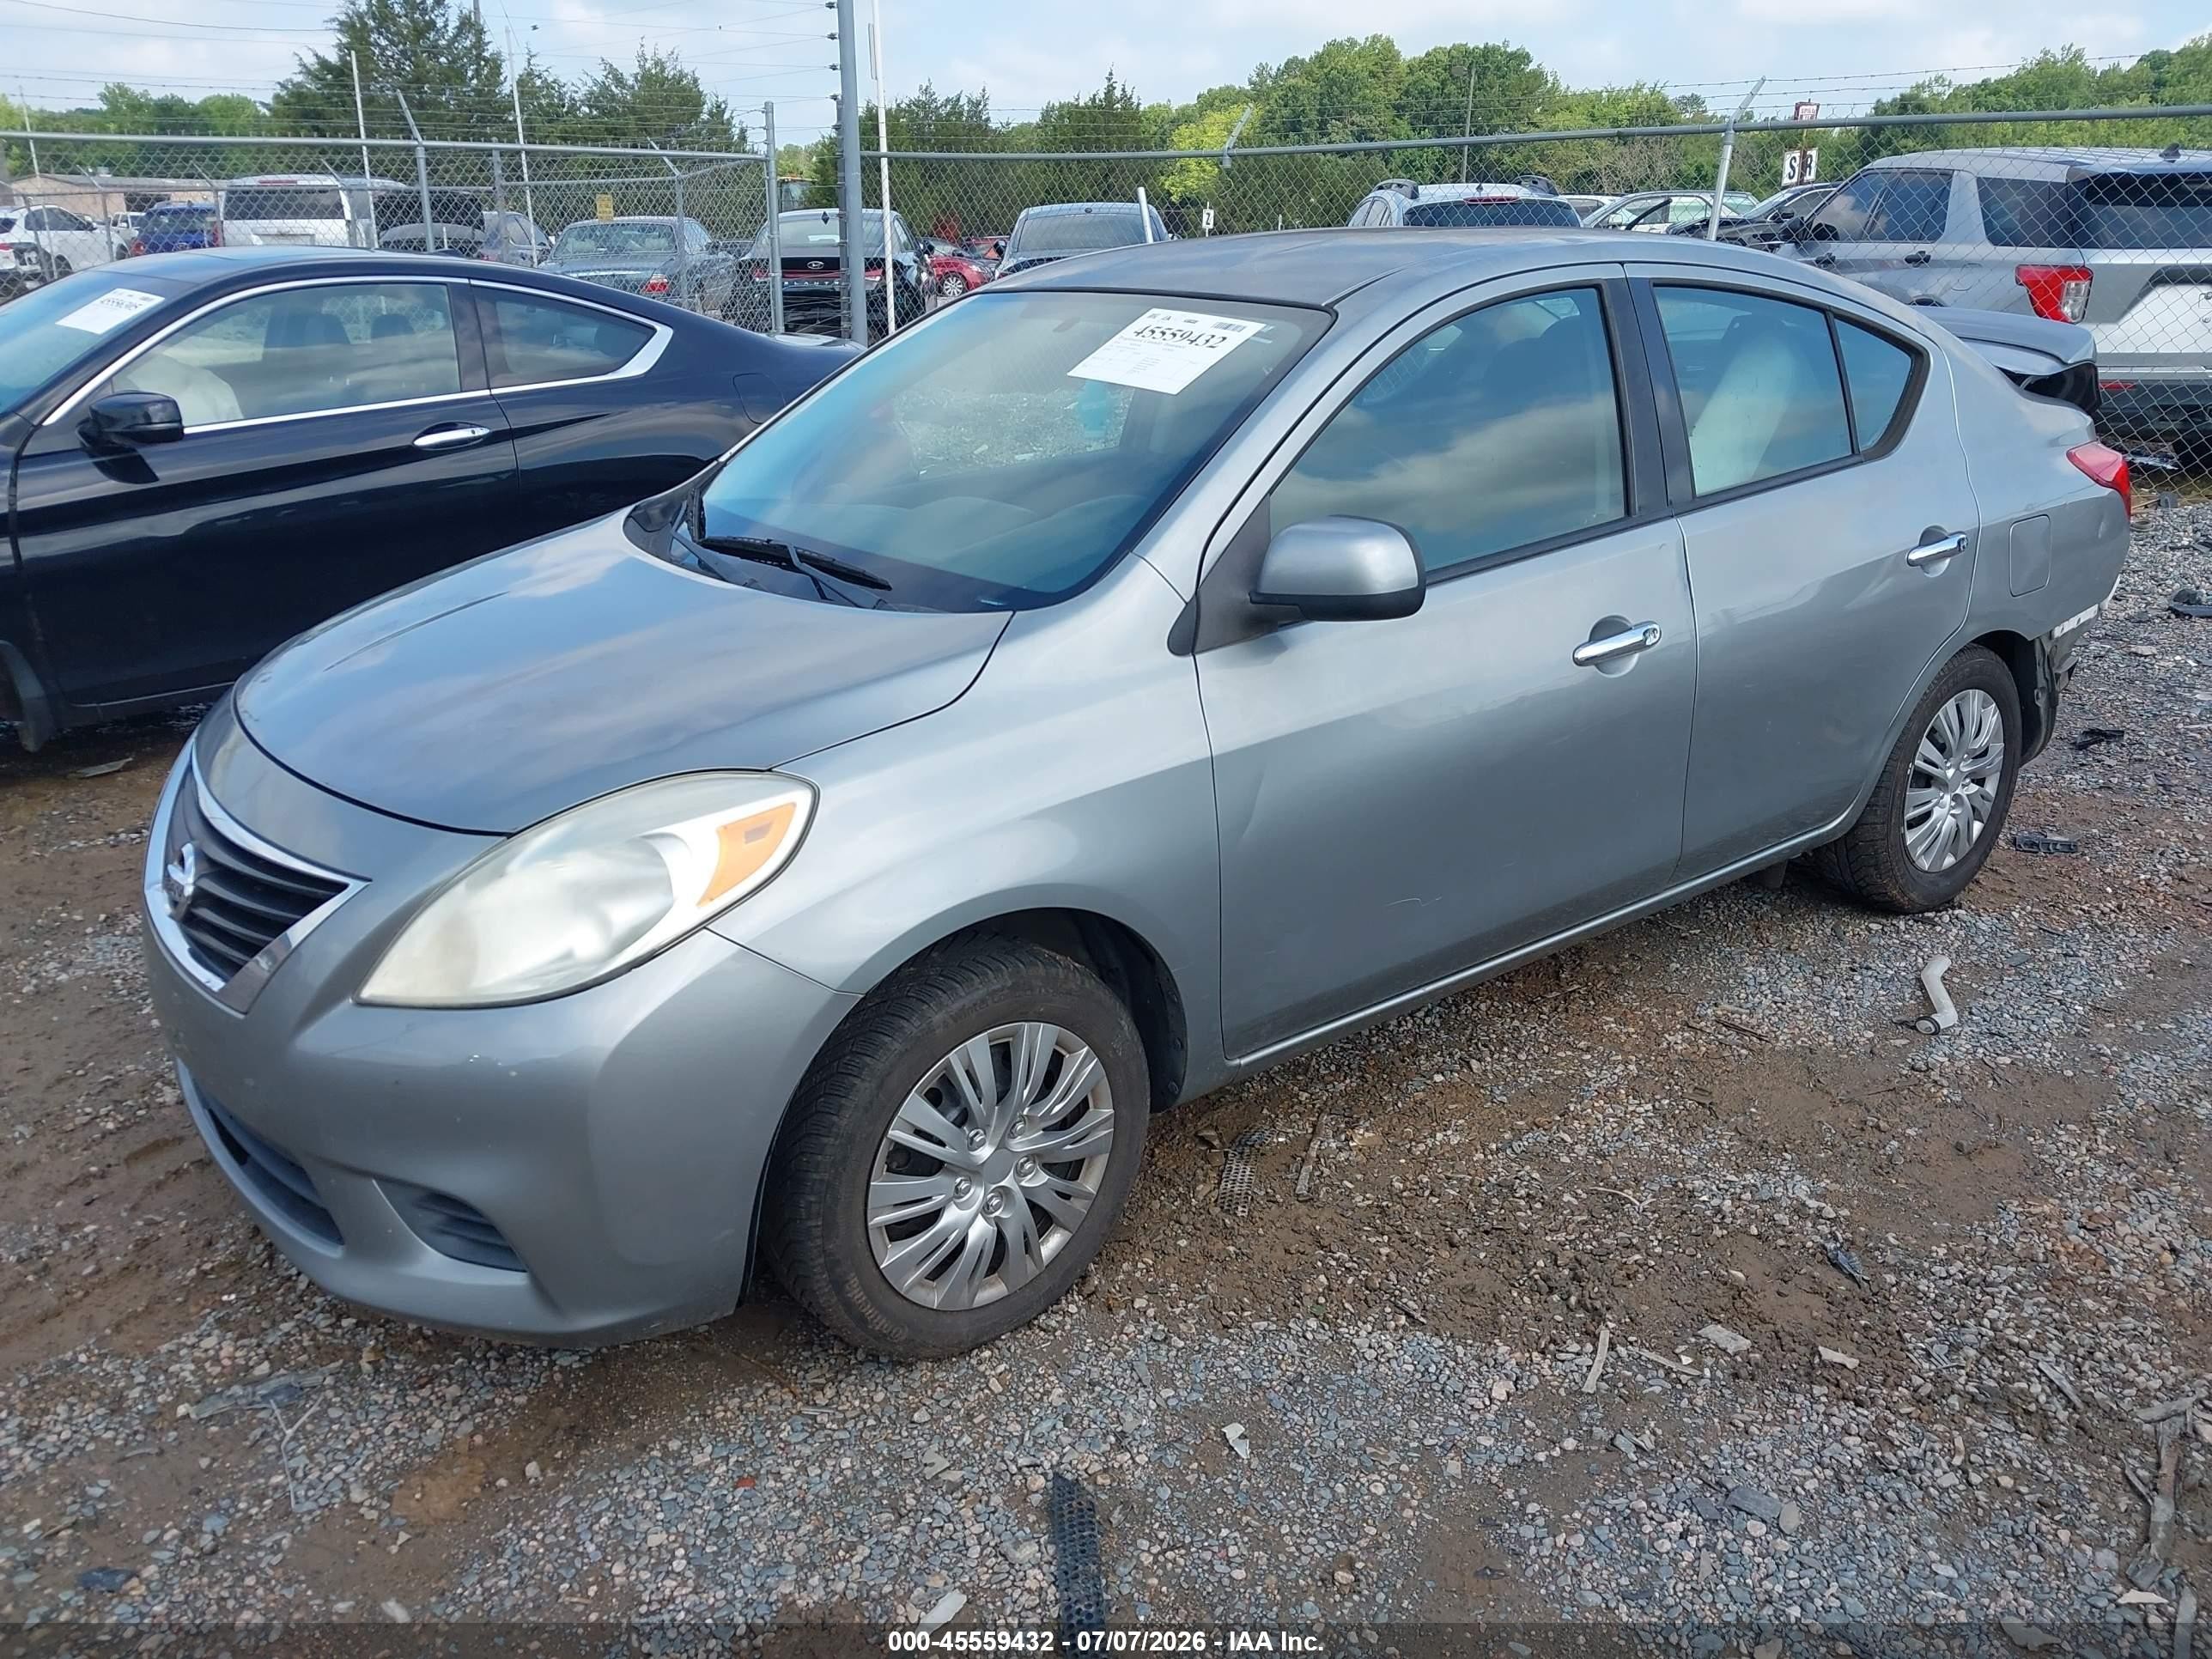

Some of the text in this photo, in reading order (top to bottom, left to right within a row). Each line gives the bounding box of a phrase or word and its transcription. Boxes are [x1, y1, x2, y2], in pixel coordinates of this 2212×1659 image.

[1788, 155, 1797, 180] S
[1206, 212, 1211, 225] 2
[1133, 325, 1228, 349] 45559432
